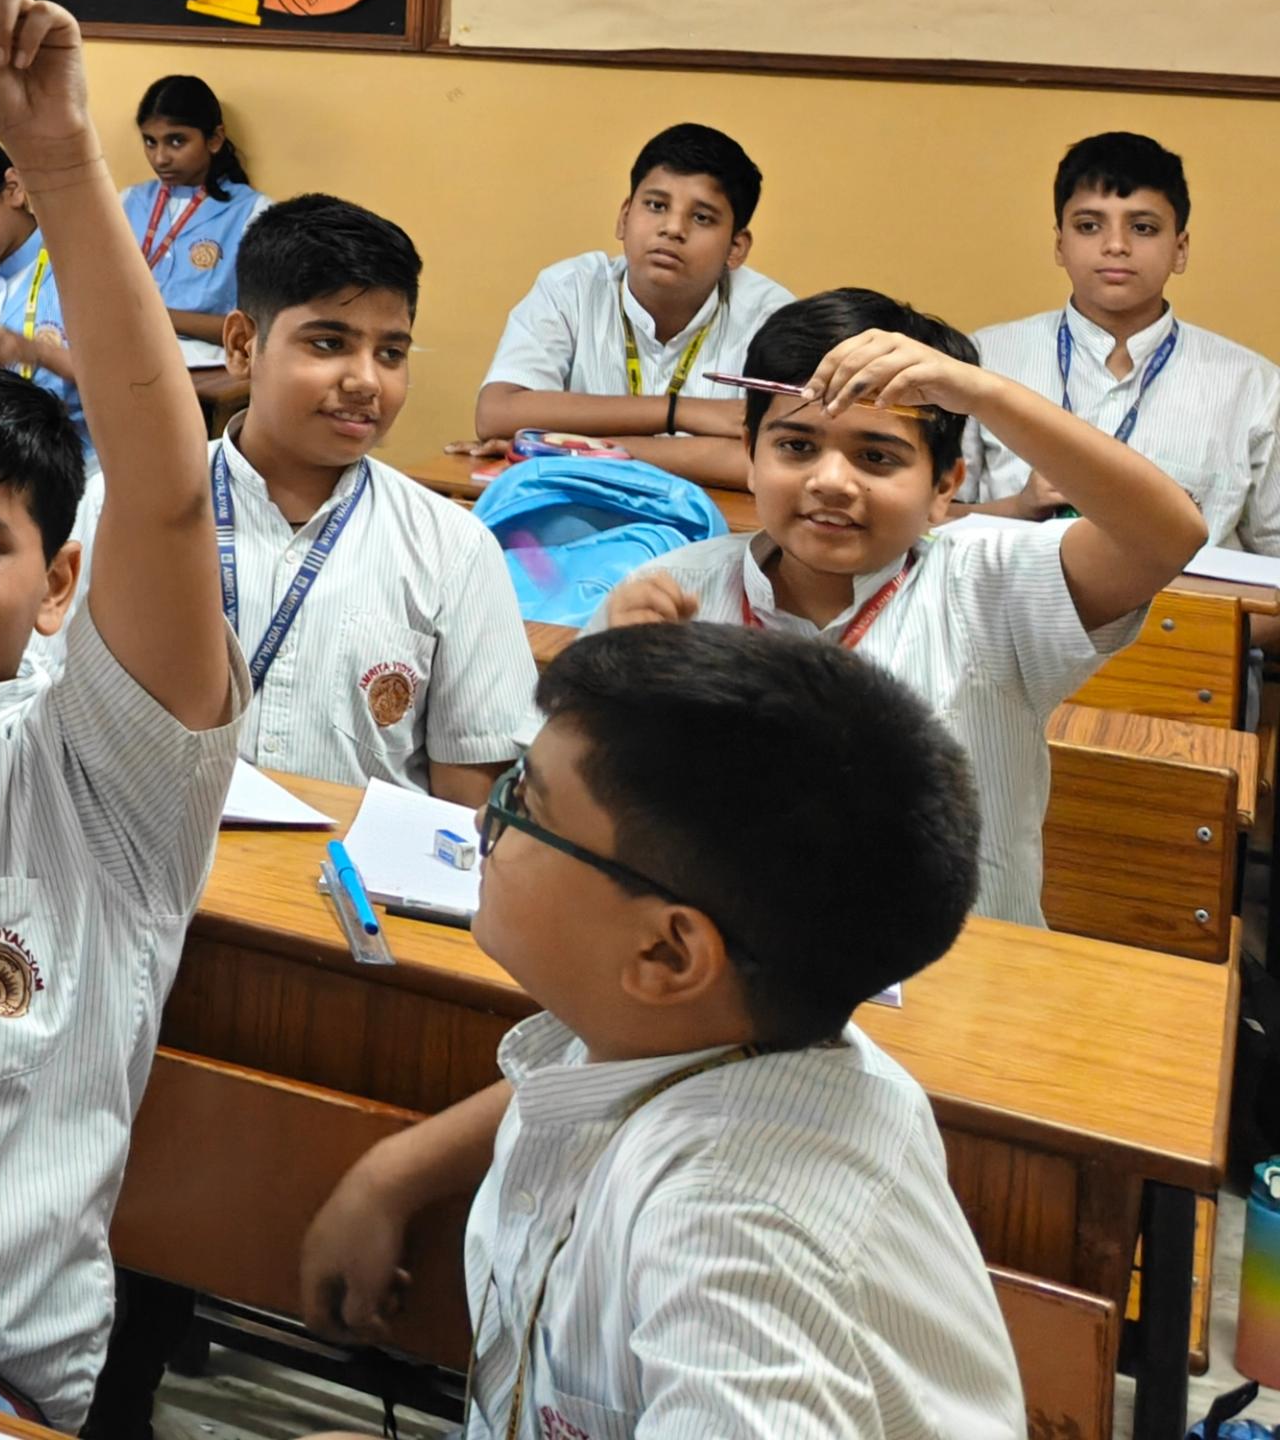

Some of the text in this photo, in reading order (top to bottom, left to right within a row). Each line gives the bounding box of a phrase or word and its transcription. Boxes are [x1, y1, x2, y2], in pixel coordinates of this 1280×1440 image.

[213, 462, 230, 521] VIDYALAYAM
[223, 564, 237, 606] AMRITA
[246, 583, 302, 690] AMRITA VIDYALAYA
[358, 661, 390, 691] AMRITA
